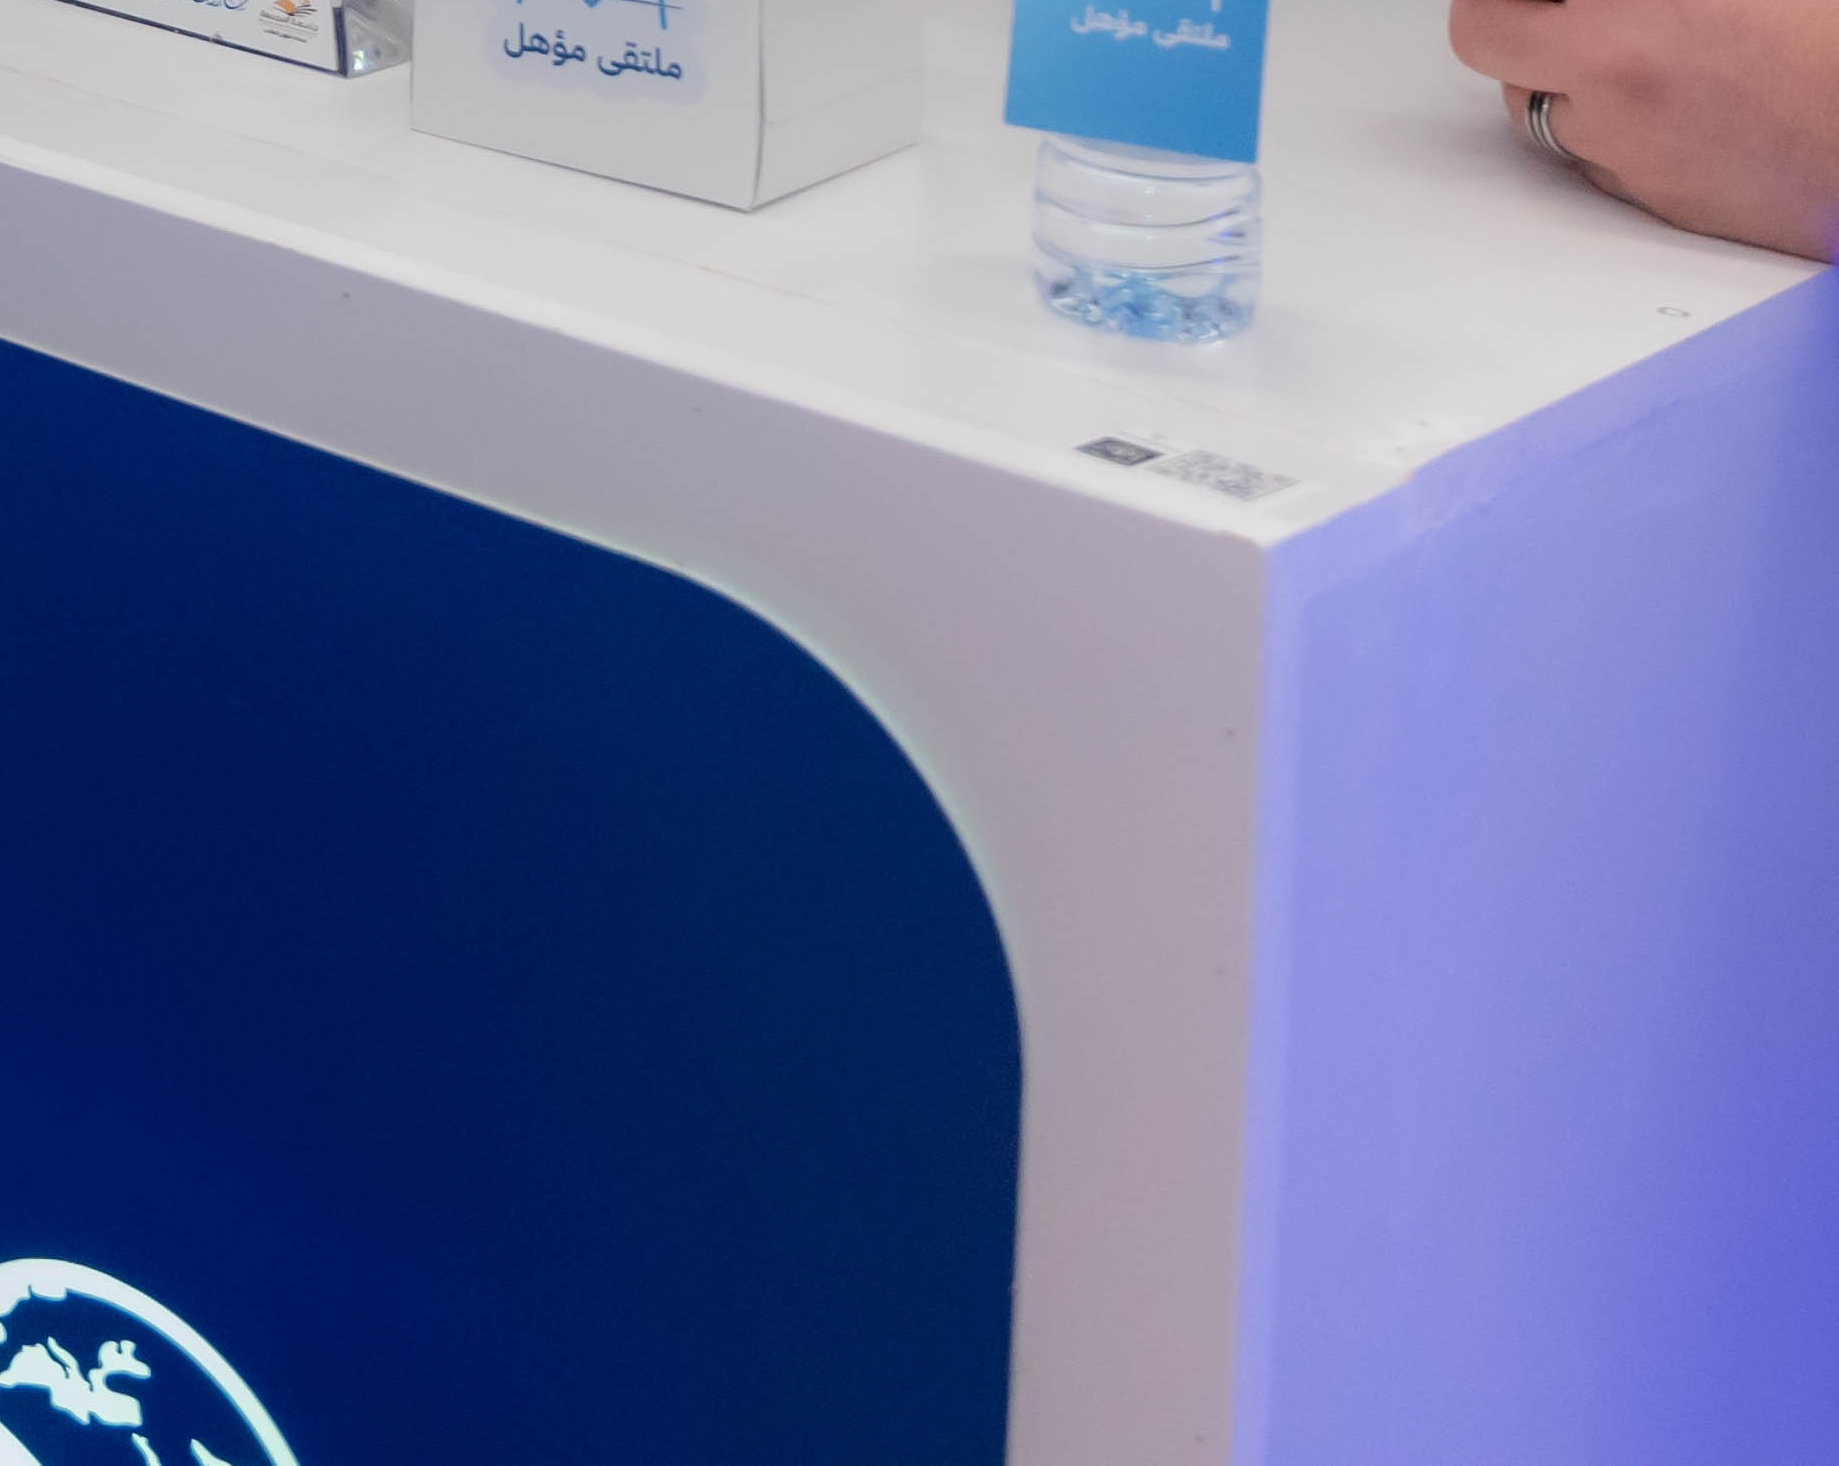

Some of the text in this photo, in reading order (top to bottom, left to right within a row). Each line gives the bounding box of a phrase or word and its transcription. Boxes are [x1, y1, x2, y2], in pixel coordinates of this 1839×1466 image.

[503, 21, 683, 80] ملتقى مؤهل
[1070, 5, 1230, 51] ملتقى مؤهل
